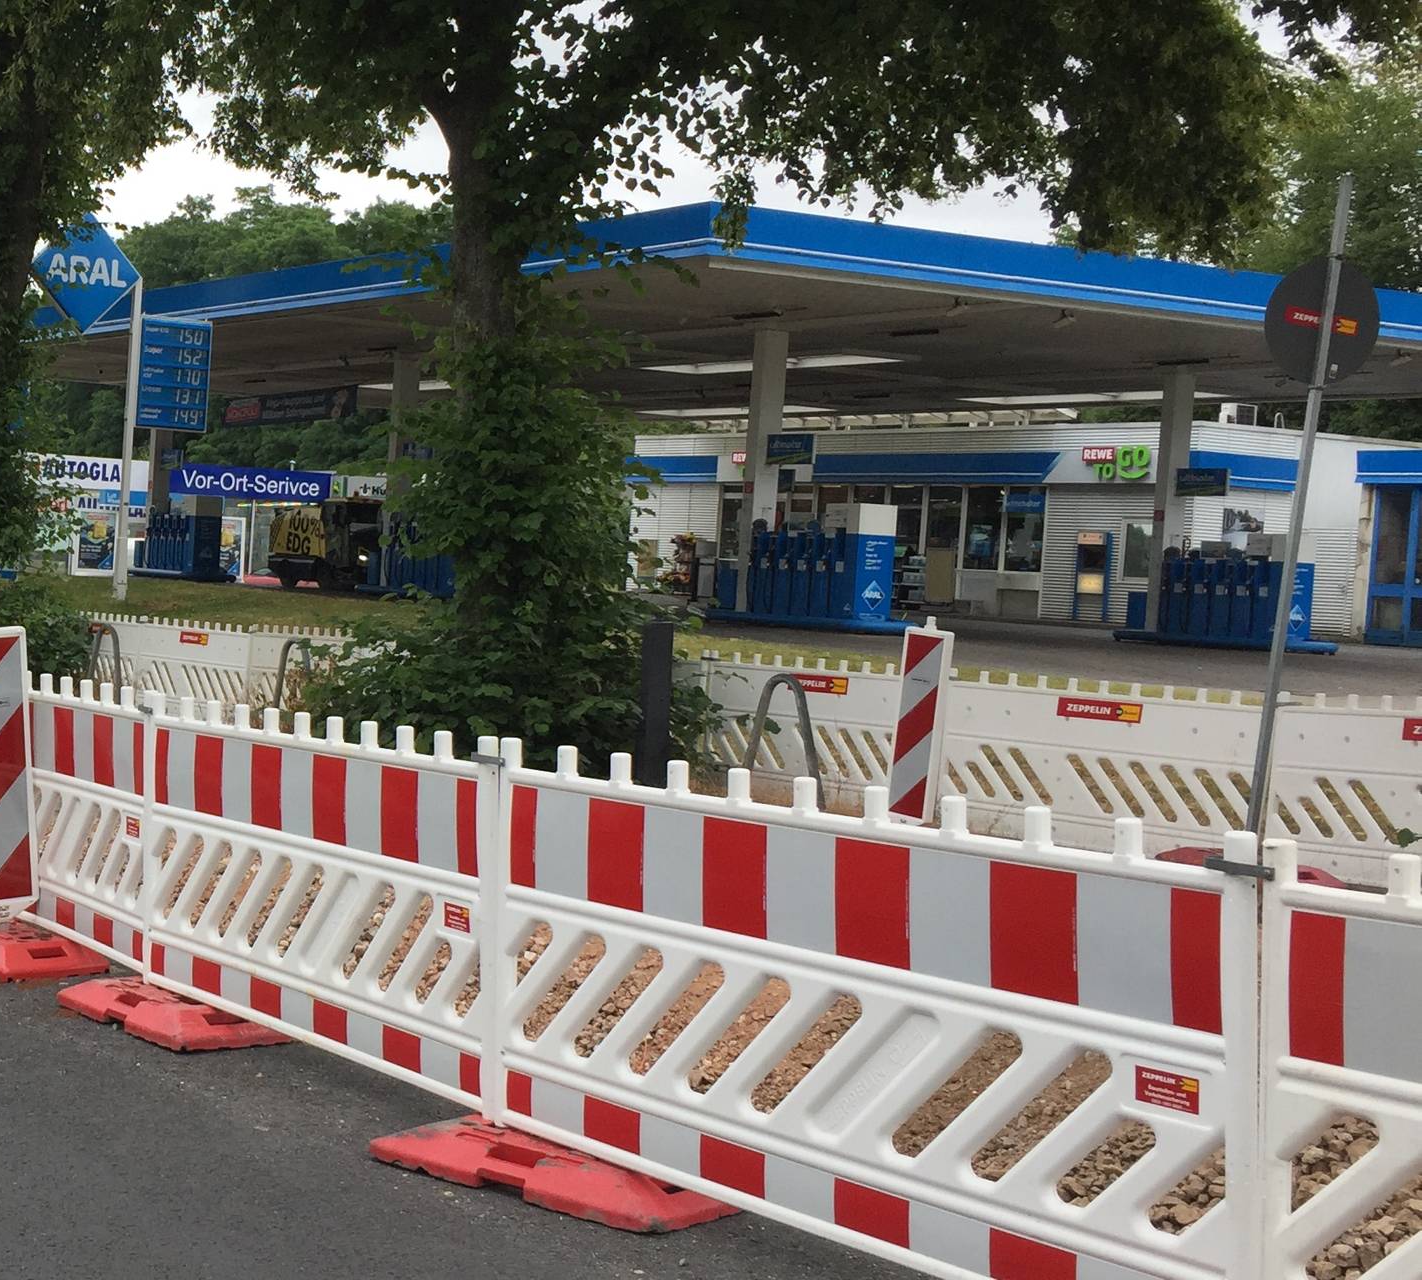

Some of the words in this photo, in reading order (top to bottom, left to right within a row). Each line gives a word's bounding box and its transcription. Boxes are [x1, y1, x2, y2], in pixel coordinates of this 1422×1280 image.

[46, 253, 127, 288] ARAL
[1293, 312, 1321, 324] ZEPPE
[1083, 448, 1114, 460] REWE
[1117, 444, 1151, 469] GO
[43, 458, 121, 483] AUTOGLA
[1093, 463, 1116, 480] TO
[181, 468, 320, 498] Vor-Ort-Serivce
[286, 531, 311, 555] EDG
[1066, 703, 1111, 715] ZEPPELIN
